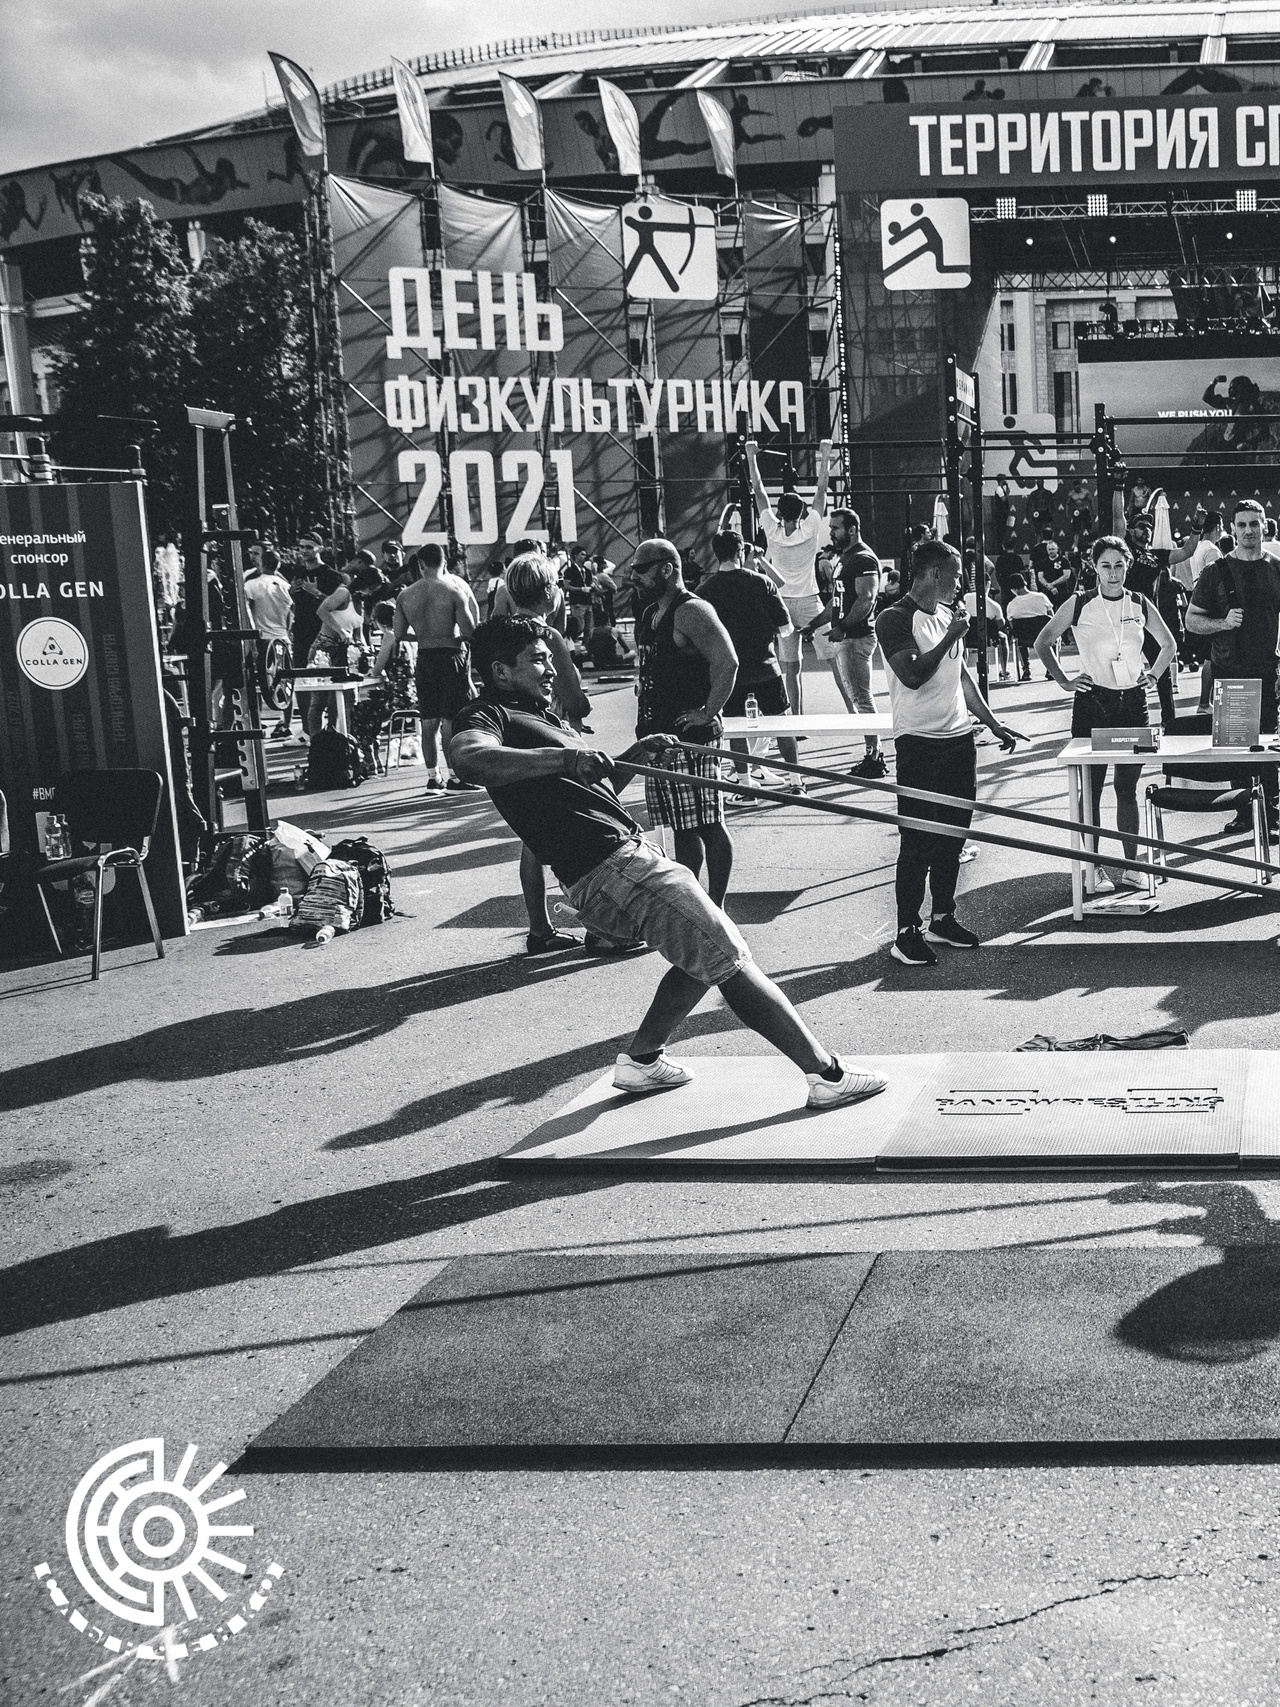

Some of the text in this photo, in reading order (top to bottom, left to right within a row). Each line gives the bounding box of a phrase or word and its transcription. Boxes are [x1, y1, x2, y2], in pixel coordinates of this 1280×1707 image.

[909, 107, 1219, 176] ТЕРРИТОРИЯ
[387, 267, 564, 360] ДЕНЬ
[384, 375, 806, 433] ФИЗКУЛЬТУРНИКА
[1209, 409, 1232, 418] YOU
[398, 450, 578, 546] 2021
[0, 530, 86, 547] енеральный
[11, 553, 69, 566] спонсор
[60, 581, 104, 598] GEN
